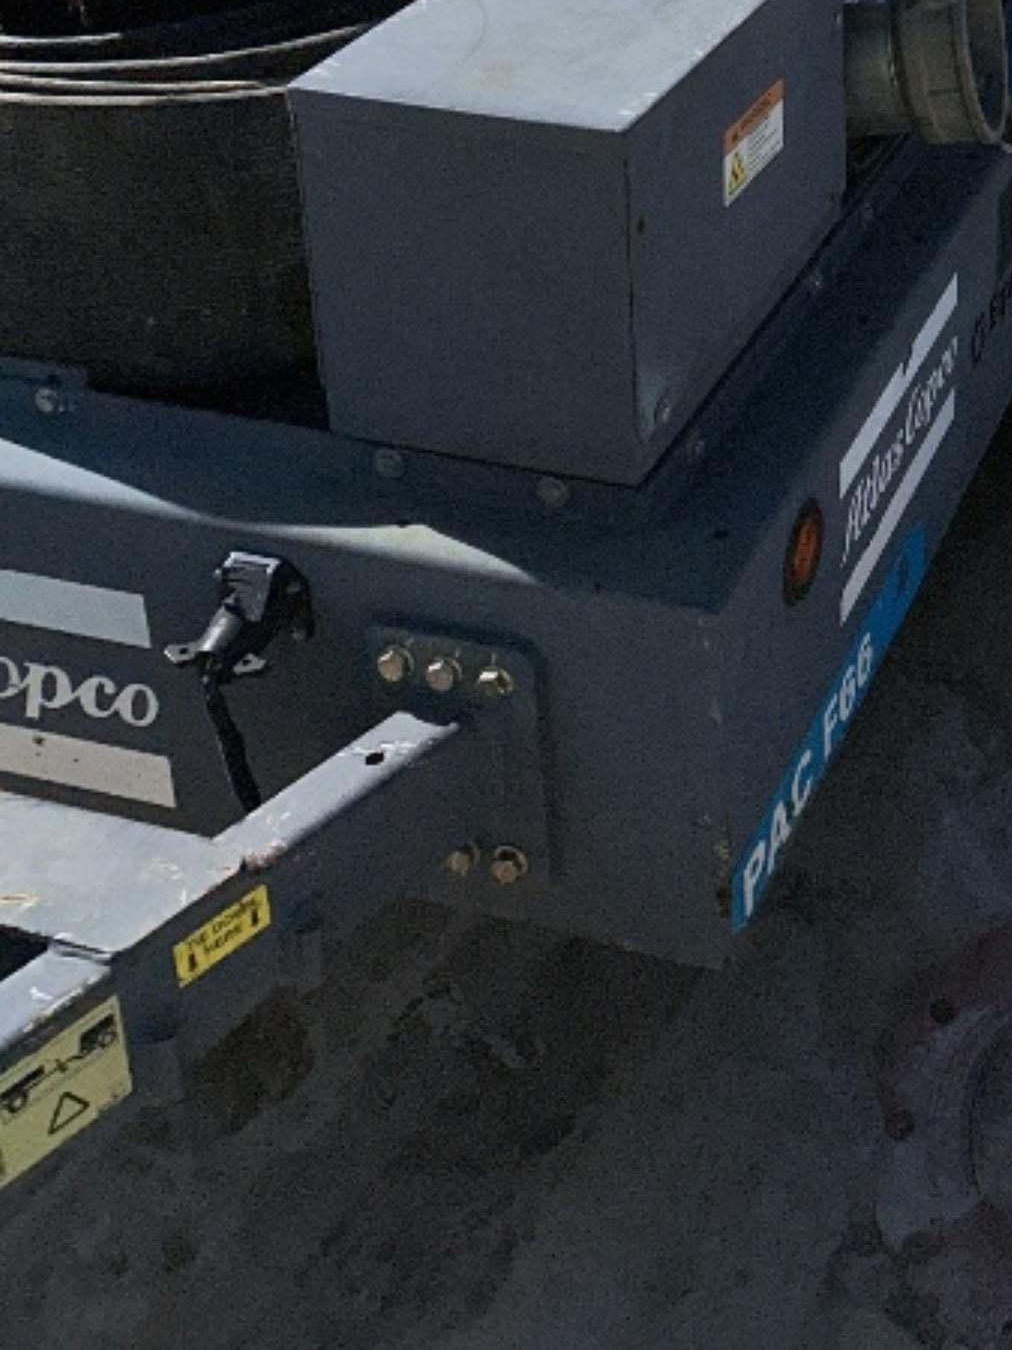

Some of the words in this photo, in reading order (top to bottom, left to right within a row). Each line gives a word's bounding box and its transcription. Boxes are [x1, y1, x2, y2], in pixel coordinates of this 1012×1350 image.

[840, 429, 905, 568] Atlas
[741, 746, 814, 917] PAC
[822, 631, 875, 758] F66
